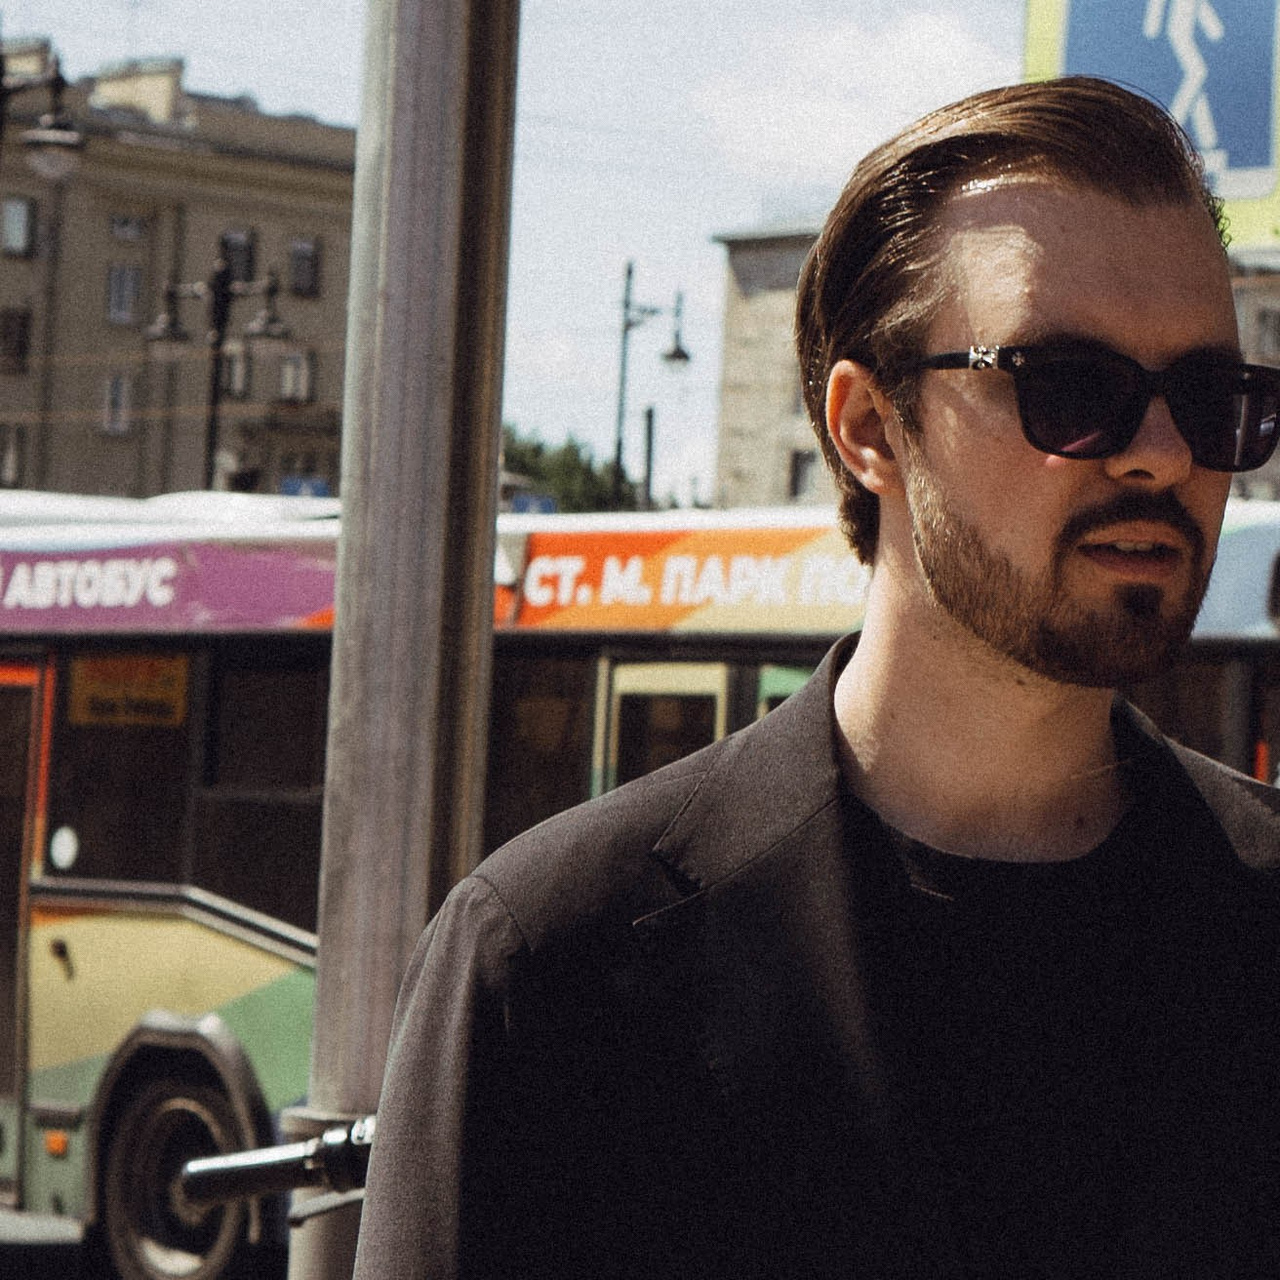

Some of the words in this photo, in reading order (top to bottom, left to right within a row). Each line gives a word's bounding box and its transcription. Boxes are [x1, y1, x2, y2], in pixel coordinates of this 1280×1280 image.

[3, 557, 178, 609] АВТОБУС
[523, 554, 593, 607] СТ.
[600, 554, 651, 606] М.
[660, 554, 789, 606] ПАРК
[797, 554, 872, 606] ПО
